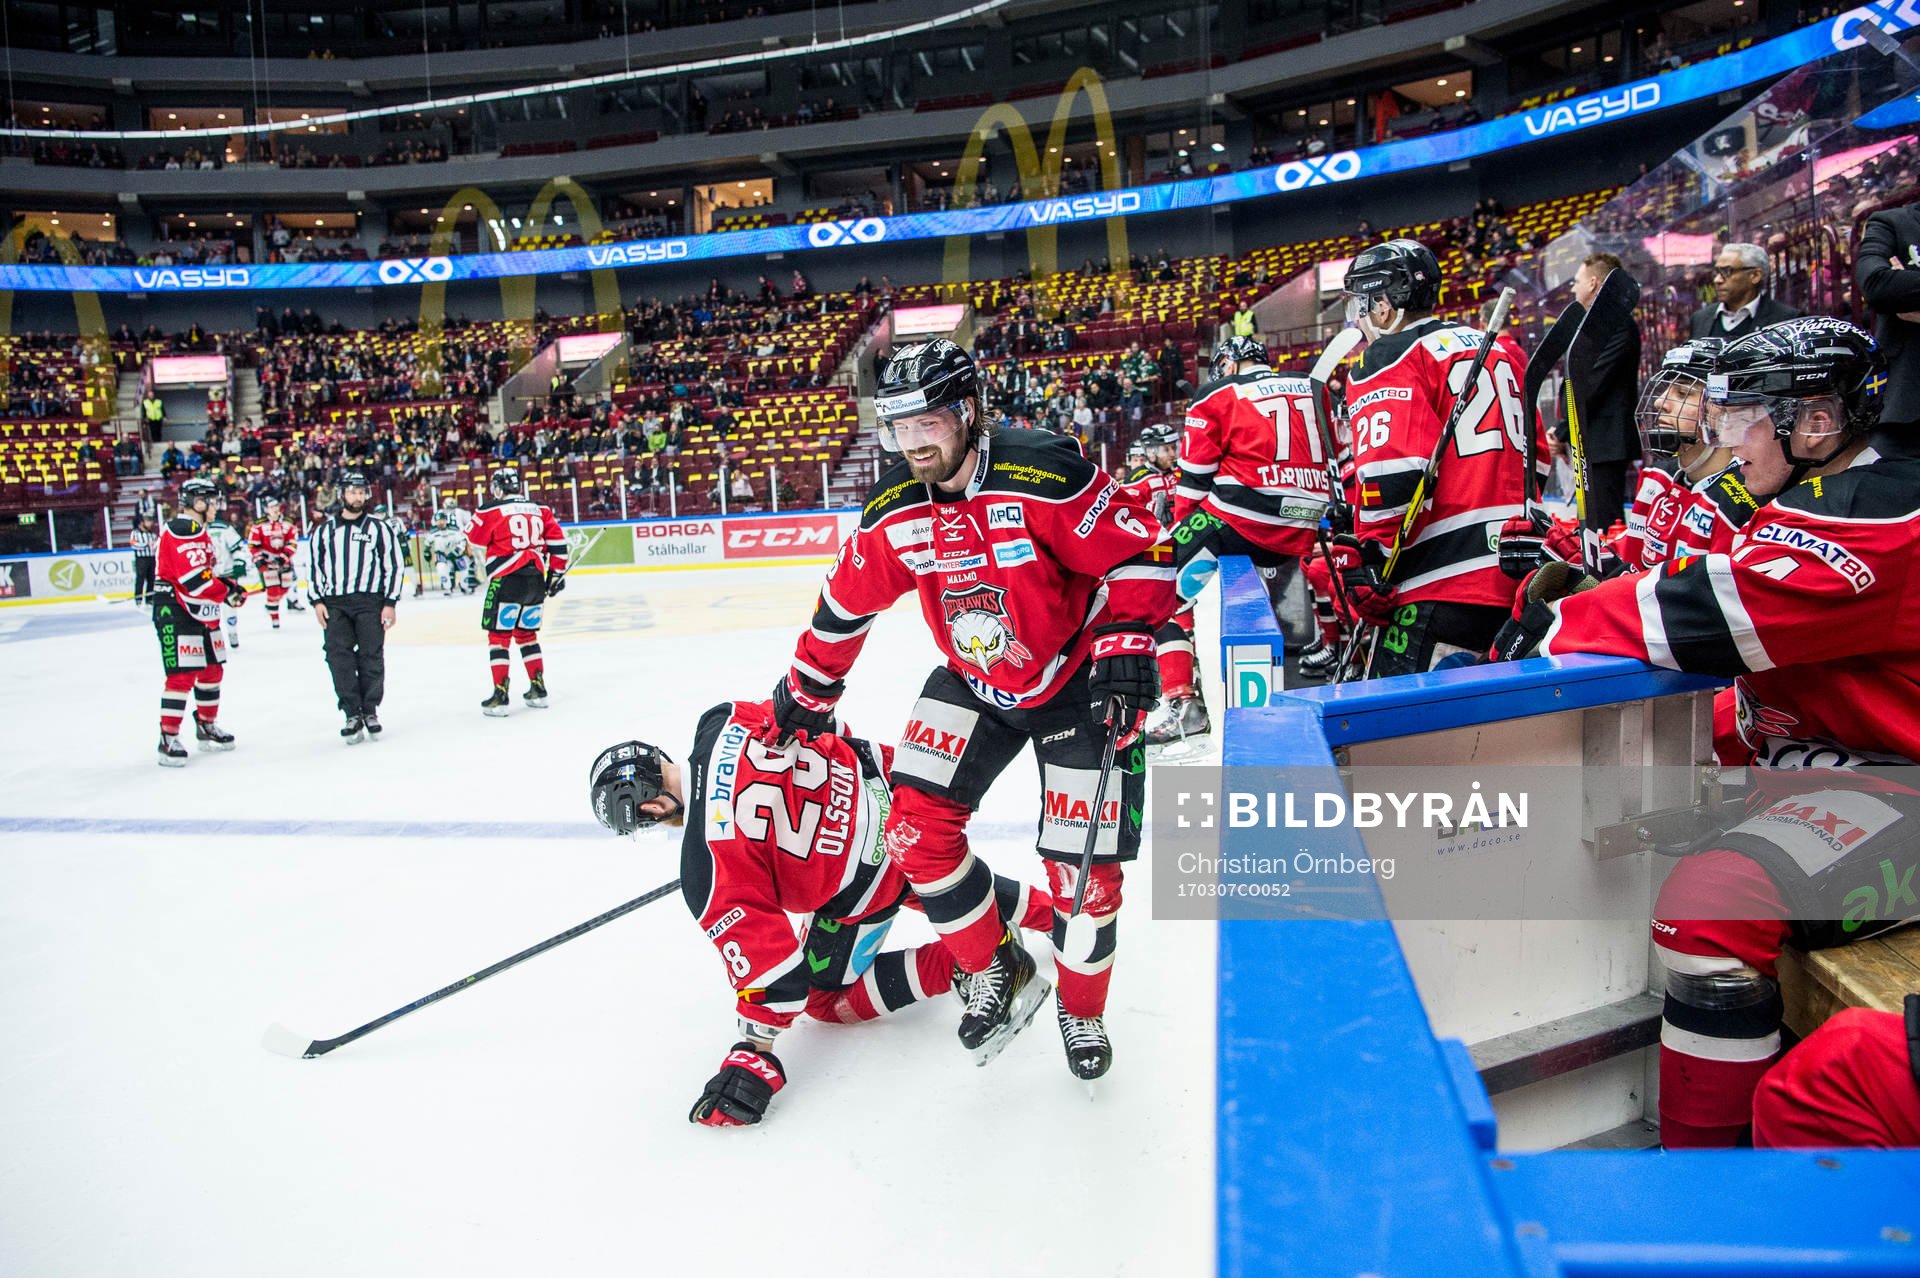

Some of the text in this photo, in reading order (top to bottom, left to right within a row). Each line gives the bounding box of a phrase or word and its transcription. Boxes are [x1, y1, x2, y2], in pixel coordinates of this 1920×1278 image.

[1525, 82, 1660, 136] VASYD
[1275, 150, 1361, 192] OXO
[1029, 192, 1141, 223] VASYD
[808, 217, 886, 248] OXO
[588, 241, 688, 266] VASYD
[134, 268, 250, 289] VASYD
[378, 256, 454, 285] OXO
[1362, 279, 1383, 290] CCM
[1796, 371, 1828, 381] CCM
[1349, 389, 1409, 414] CLIMAT80
[1447, 358, 1526, 459] 26
[1252, 396, 1325, 464] 71
[1356, 410, 1392, 457] 26
[1031, 476, 1041, 484] AB
[940, 506, 958, 515] SHL
[1114, 507, 1150, 539] 6
[636, 522, 715, 539] BORGA
[727, 525, 834, 549] CCM
[186, 549, 207, 567] 23
[648, 542, 707, 557] Stålhallar
[943, 550, 970, 559] CCM
[1757, 525, 1872, 589] CLIMAT80
[162, 624, 177, 668] akea
[1239, 671, 1267, 708] D
[903, 719, 967, 757] MAXI
[1041, 727, 1076, 745] CCM
[903, 741, 958, 763] STORMARKNAD
[734, 737, 830, 862] 28
[815, 759, 858, 857] OLSSON
[1046, 790, 1119, 822] MAXI
[1054, 817, 1117, 830] STORMANAD
[1756, 815, 1844, 852] STORMARKNAD
[1760, 802, 1868, 847] MAXI
[1437, 832, 1521, 856] www.daco.se
[722, 940, 752, 987] 8
